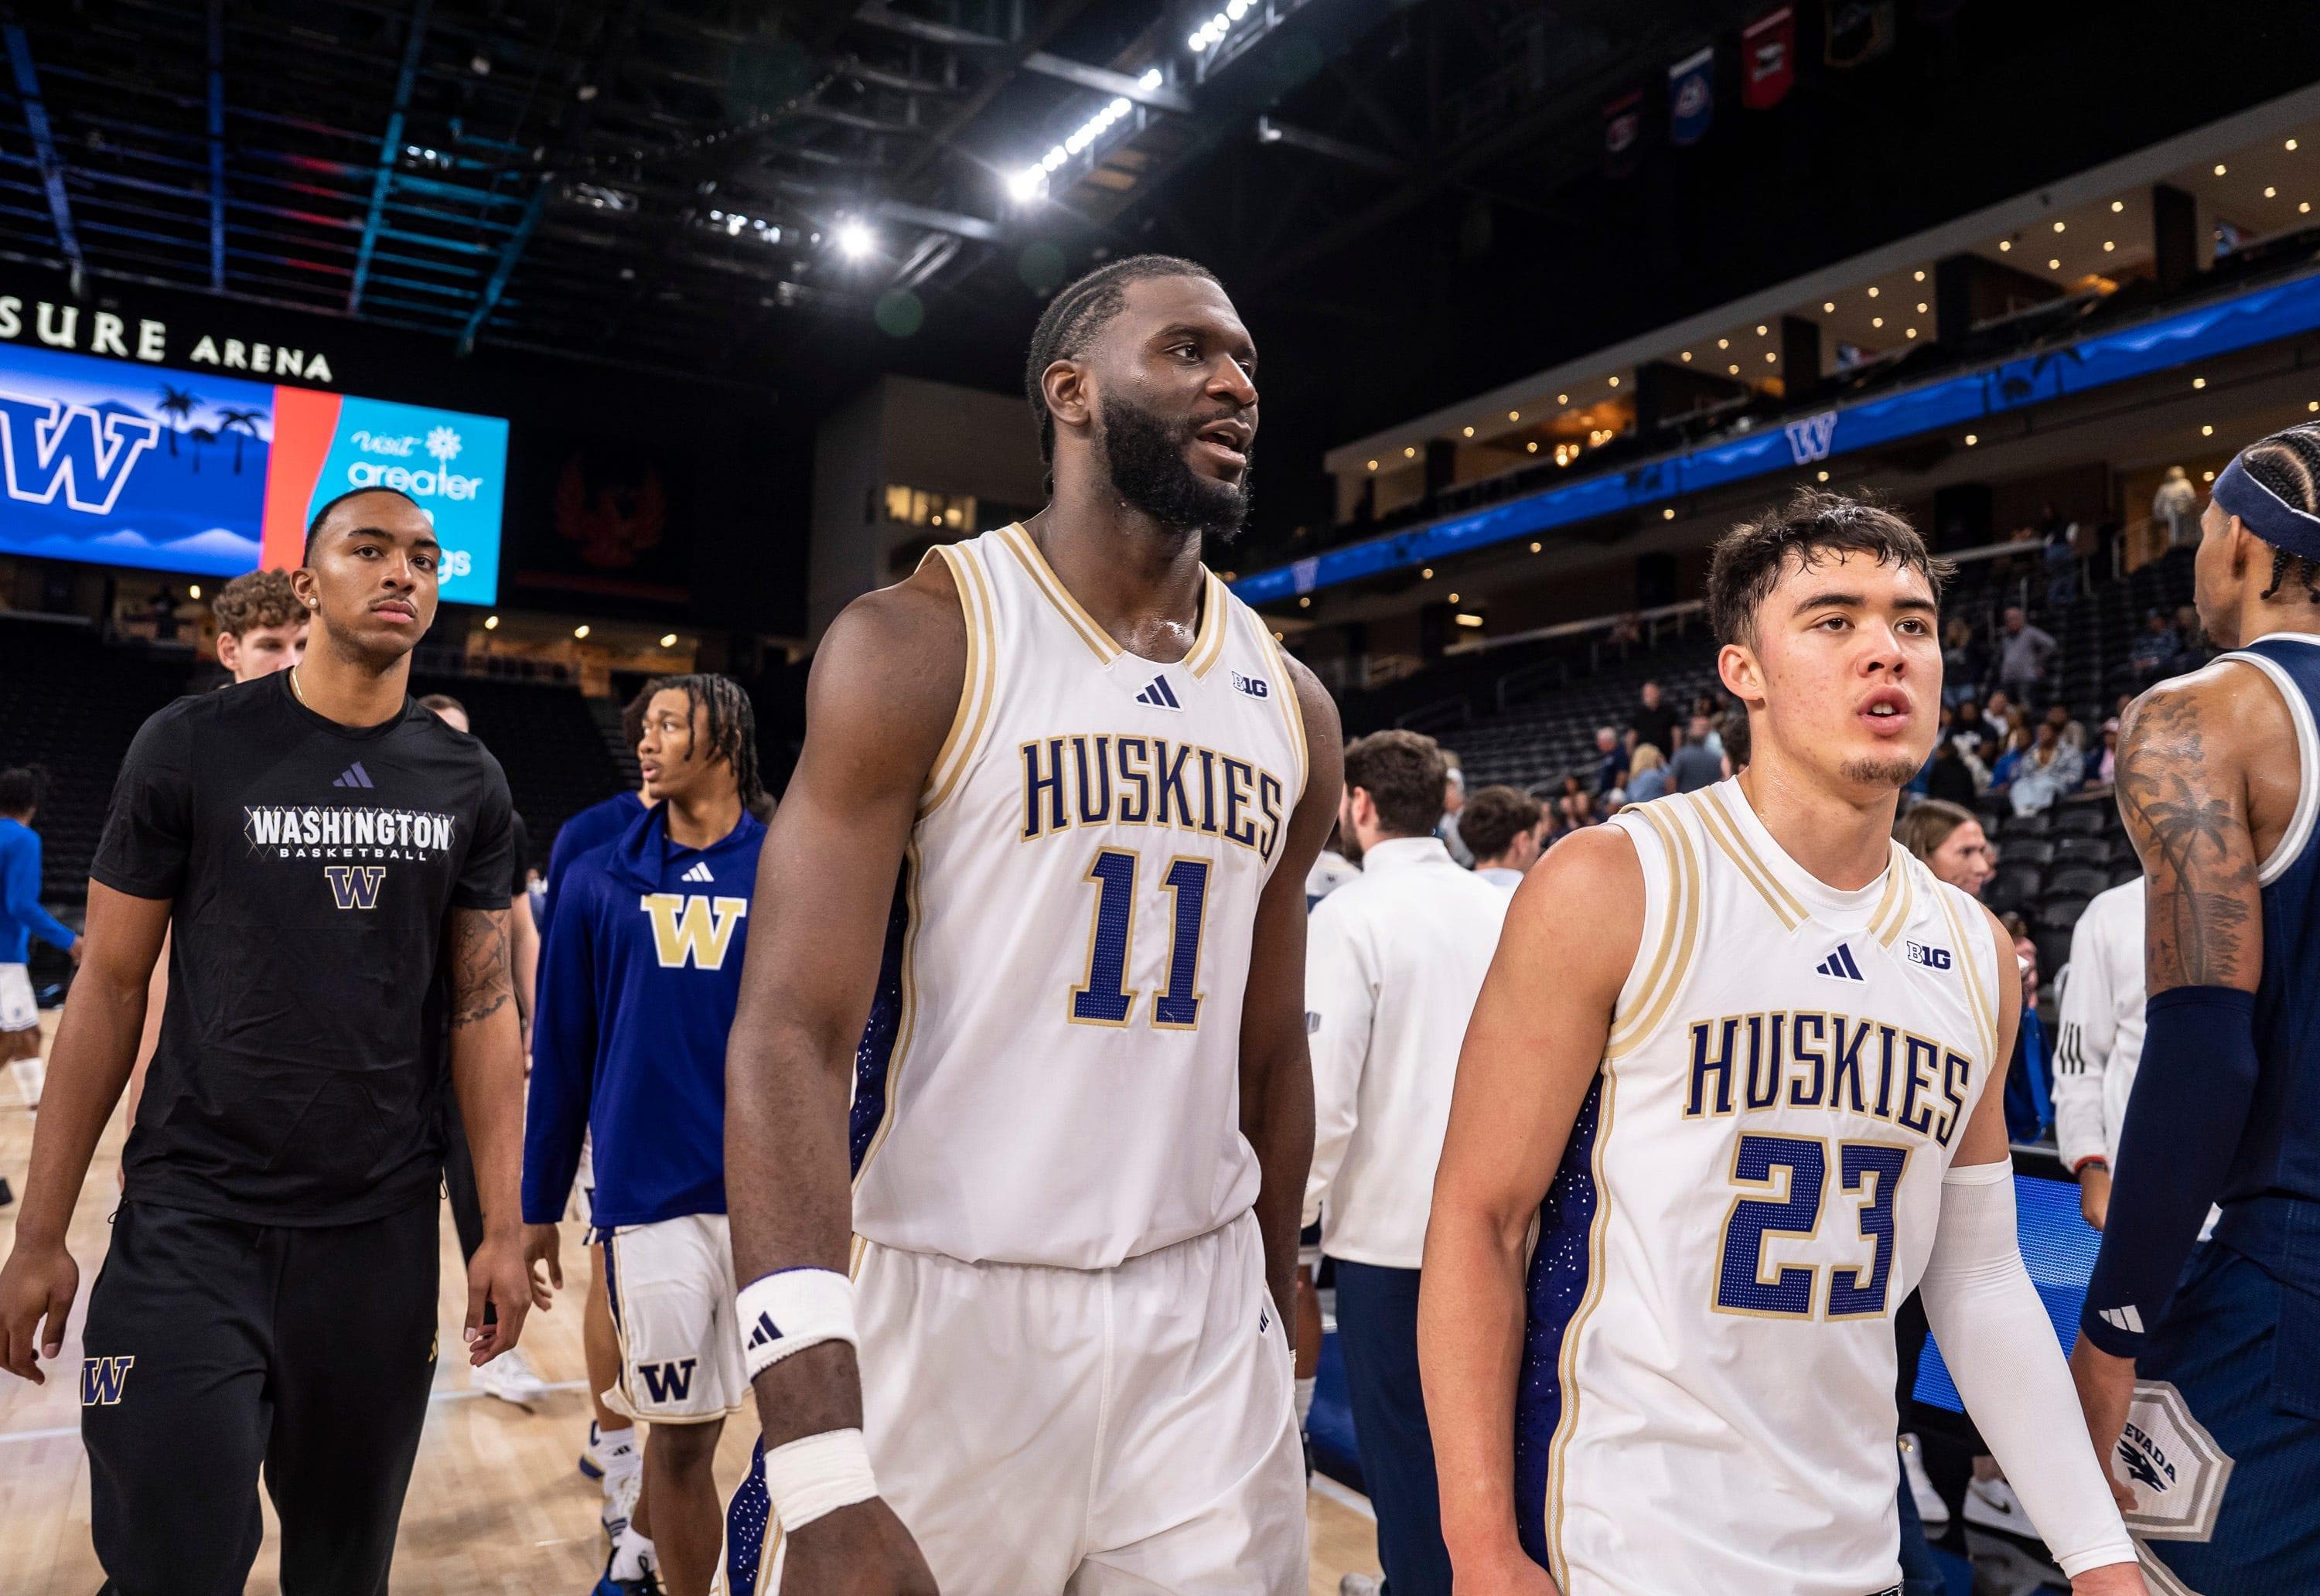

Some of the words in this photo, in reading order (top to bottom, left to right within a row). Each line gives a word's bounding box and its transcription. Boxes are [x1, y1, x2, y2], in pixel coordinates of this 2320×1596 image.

[189, 335, 333, 383] ARENA
[0, 389, 160, 516] W
[1784, 411, 1837, 466] W
[1018, 734, 1285, 867] HUSKIES
[252, 810, 450, 851] WASHINGTON
[279, 848, 426, 861] BASKETBALL
[324, 866, 387, 909] W
[640, 893, 747, 971] W
[1067, 846, 1213, 1031] 11
[1682, 1010, 1974, 1151] HUSKIES
[1711, 1130, 1914, 1322] 23
[82, 1355, 135, 1407] W
[638, 1358, 697, 1404] W
[2124, 1421, 2177, 1485] EVADA
